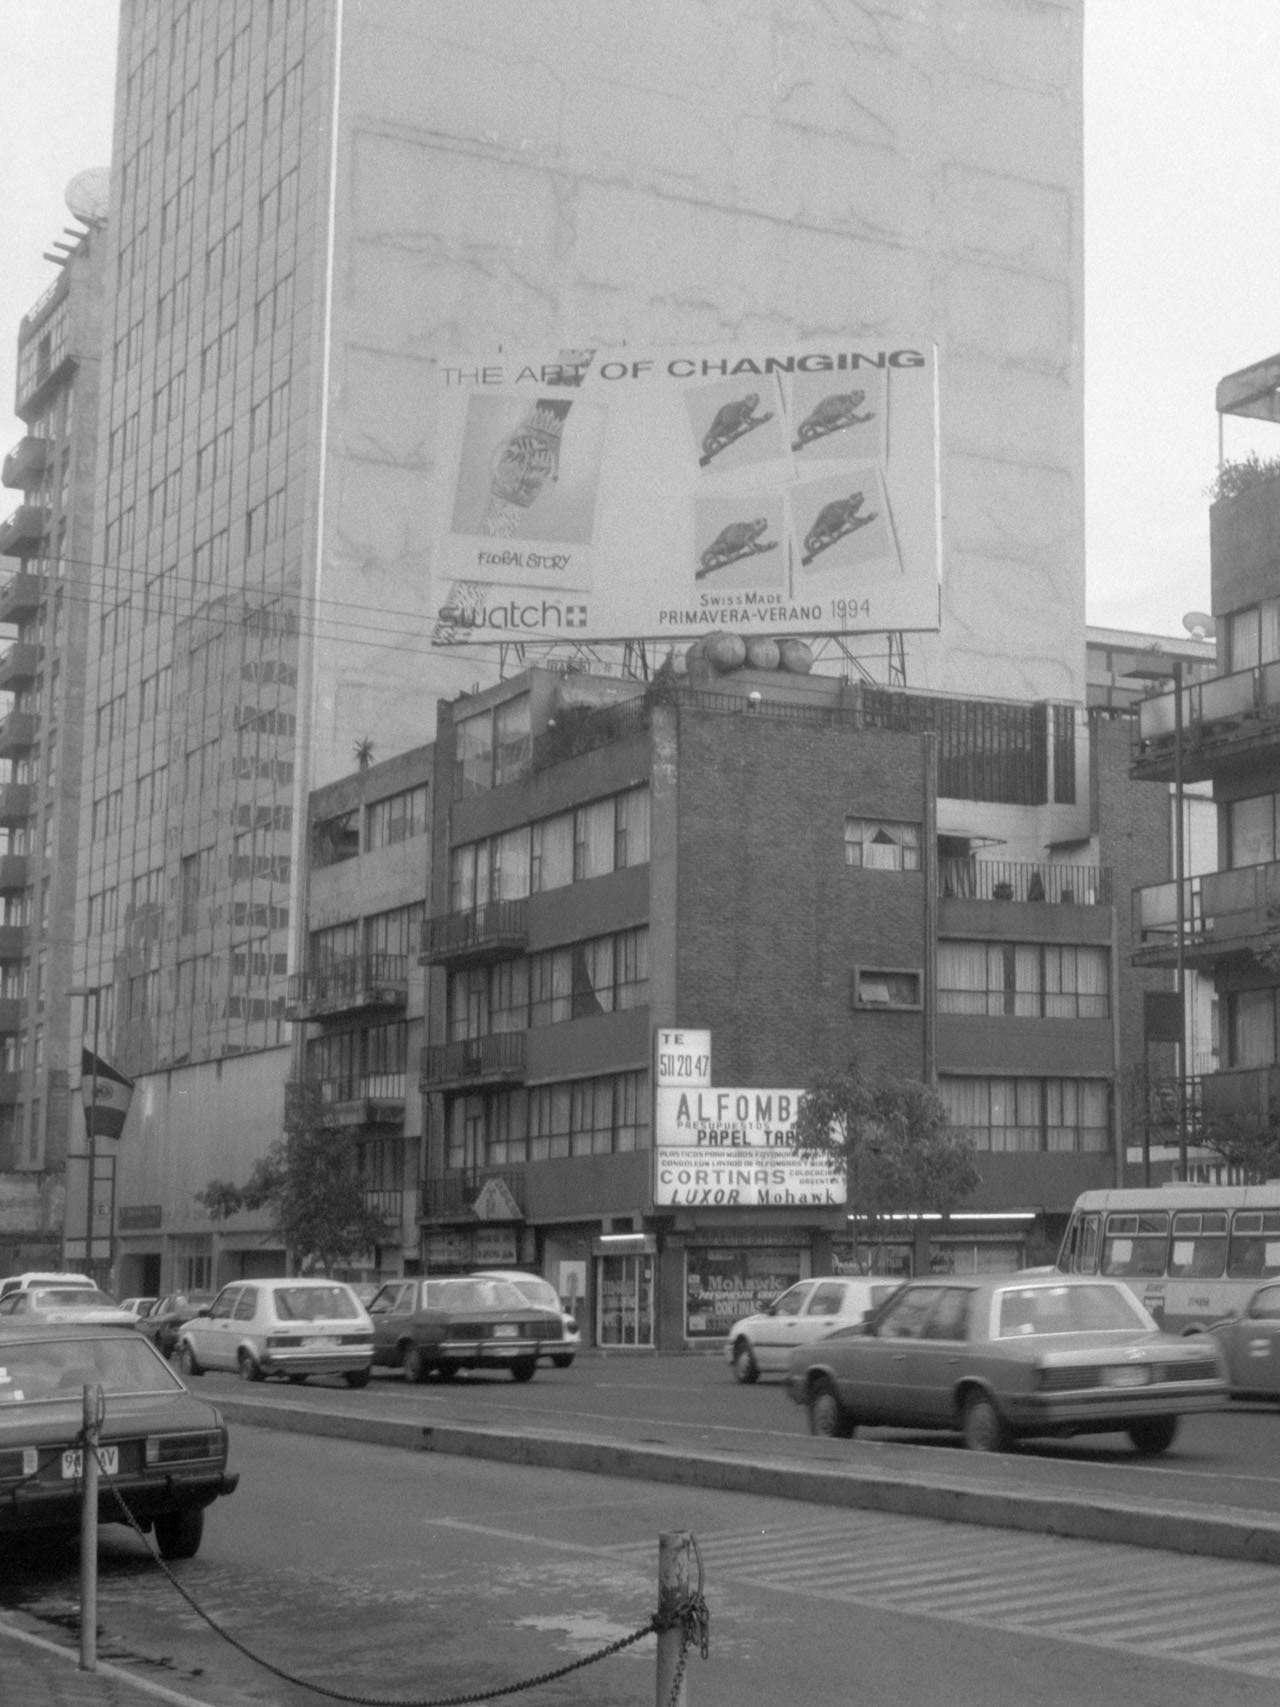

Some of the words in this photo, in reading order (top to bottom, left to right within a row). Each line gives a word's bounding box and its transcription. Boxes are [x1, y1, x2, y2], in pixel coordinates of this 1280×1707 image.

[439, 365, 502, 385] THE
[514, 362, 594, 386] ART
[600, 358, 653, 380] OF
[666, 348, 926, 378] CHANGING
[437, 600, 562, 629] swatch
[659, 604, 823, 624] PRIMAVERA-VERANO
[831, 599, 871, 618] 1994
[661, 1032, 685, 1045] TE
[677, 1054, 692, 1077] 20
[695, 1054, 709, 1077] 47
[676, 1091, 806, 1122] ALFOMB
[697, 1130, 751, 1146] PAPEL
[659, 1169, 786, 1185] CORTINAS
[670, 1188, 741, 1204] LUXOR
[756, 1188, 836, 1204] Mohawk
